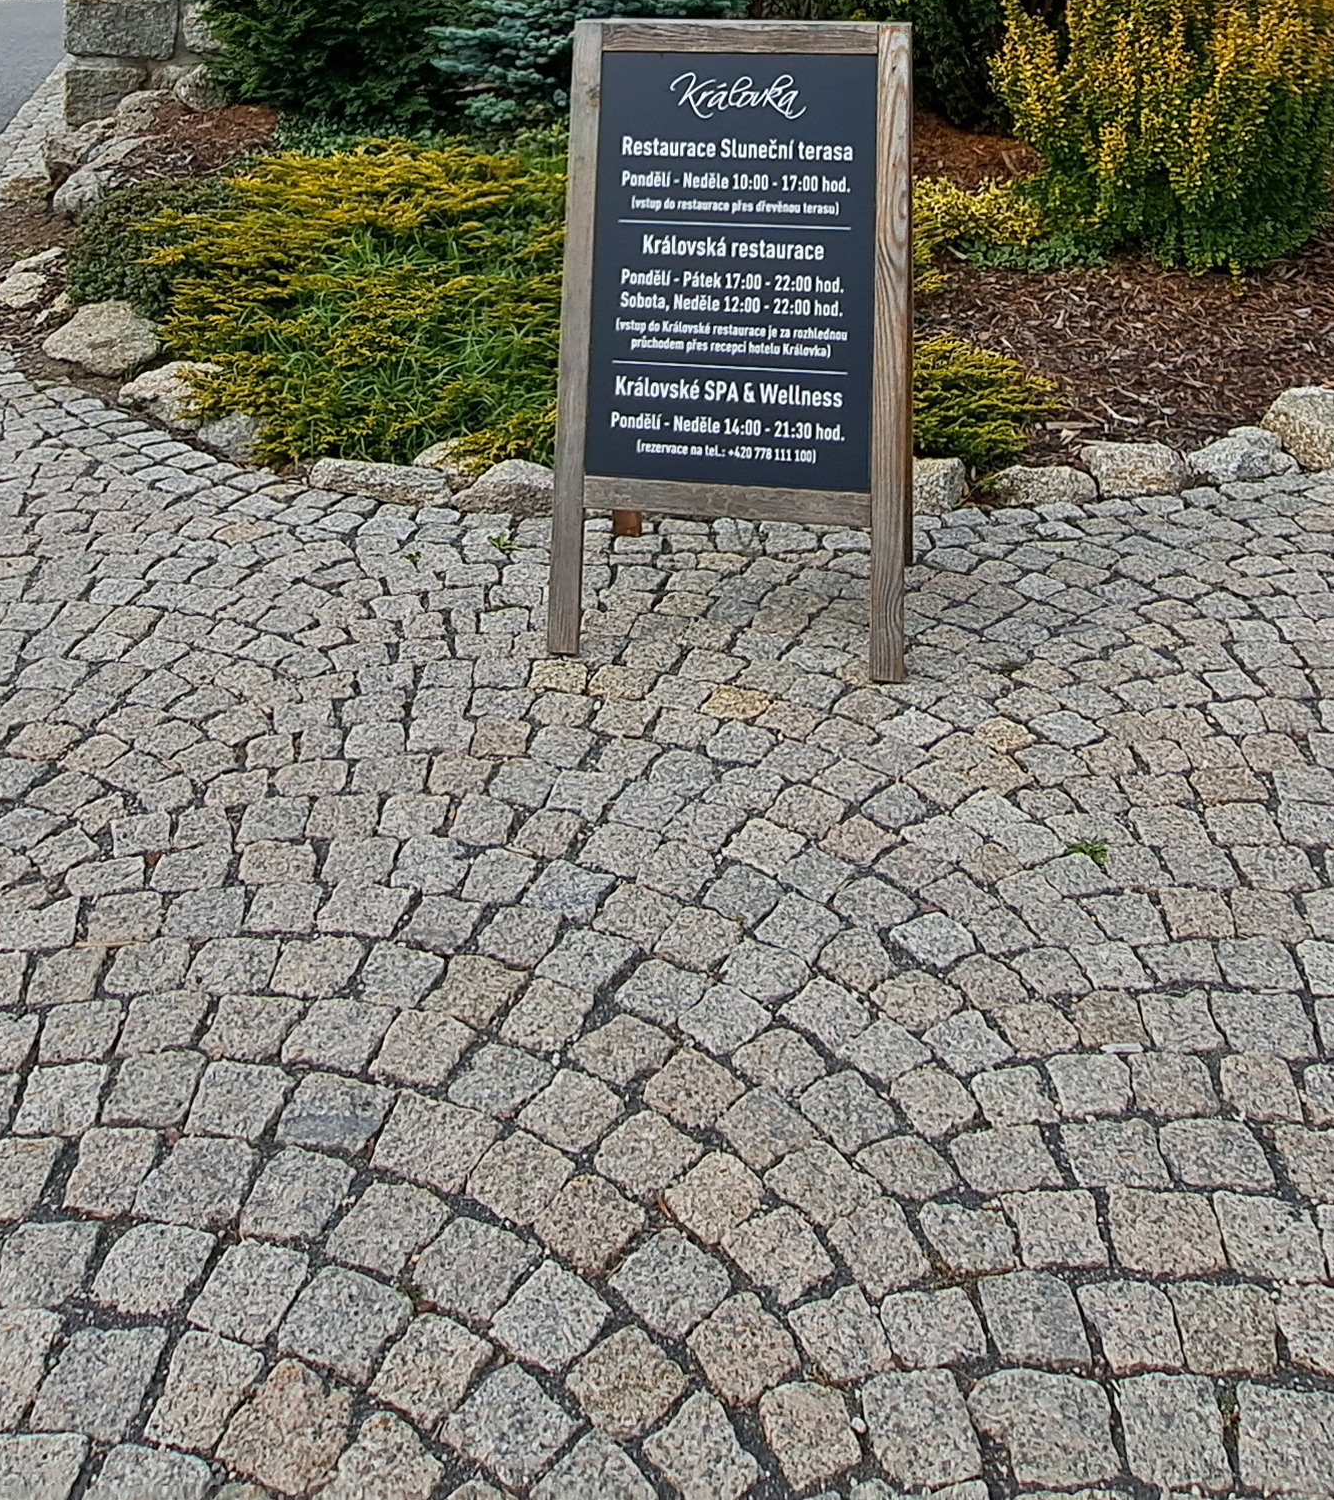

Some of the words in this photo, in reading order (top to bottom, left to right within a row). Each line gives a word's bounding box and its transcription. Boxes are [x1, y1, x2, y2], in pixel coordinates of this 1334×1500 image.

[670, 72, 807, 119] Královka
[622, 136, 716, 157] Restaurace
[720, 138, 793, 160] Sluneční
[798, 142, 853, 161] terasa
[621, 170, 671, 188] Pondělí
[683, 172, 729, 189] Neděle
[732, 173, 769, 190] 10:00
[782, 175, 818, 192] 17:00
[822, 176, 851, 193] hod.
[631, 195, 662, 212] (vstup
[664, 198, 675, 210] do
[677, 199, 729, 212] restaurace
[732, 200, 753, 214] přes
[756, 201, 801, 214] dřevěnou
[803, 202, 839, 216] terasu)
[643, 234, 726, 258] Královská
[731, 239, 824, 260] restaurace
[621, 268, 671, 286] Pondělí
[683, 271, 721, 289] Pátek
[725, 272, 761, 290] 17:00
[774, 275, 811, 292] 22:00
[815, 276, 844, 293] hod.
[620, 292, 670, 312] Sobota,
[674, 294, 720, 311] Neděle
[724, 296, 760, 313] 12:00
[773, 298, 810, 315] 22:00
[814, 300, 843, 317] hod.
[616, 317, 646, 334] (vstup
[648, 320, 660, 332] do
[662, 320, 710, 335] Královské
[713, 324, 765, 337] restaurace
[767, 325, 777, 340] je
[780, 328, 790, 339] za
[793, 327, 848, 341] rozhlednou
[631, 335, 684, 350] průchodem
[686, 338, 708, 354] přes
[748, 341, 780, 355] hotelu
[783, 343, 831, 358] Královka)
[615, 375, 699, 400] Královské
[704, 380, 739, 402] SPA
[743, 383, 755, 403] &
[760, 383, 843, 408] Wellness
[611, 411, 662, 430] Pondělí
[673, 415, 720, 434] Neděle
[724, 418, 761, 436] 14:00
[774, 421, 812, 439] 21:30
[815, 422, 845, 441] hod.
[637, 439, 688, 456] (rezervace
[690, 444, 702, 456] na
[705, 445, 725, 458] tel.:
[728, 446, 751, 460] +420
[754, 447, 772, 460] 778
[775, 449, 792, 461] 111
[794, 449, 816, 464] 100)
